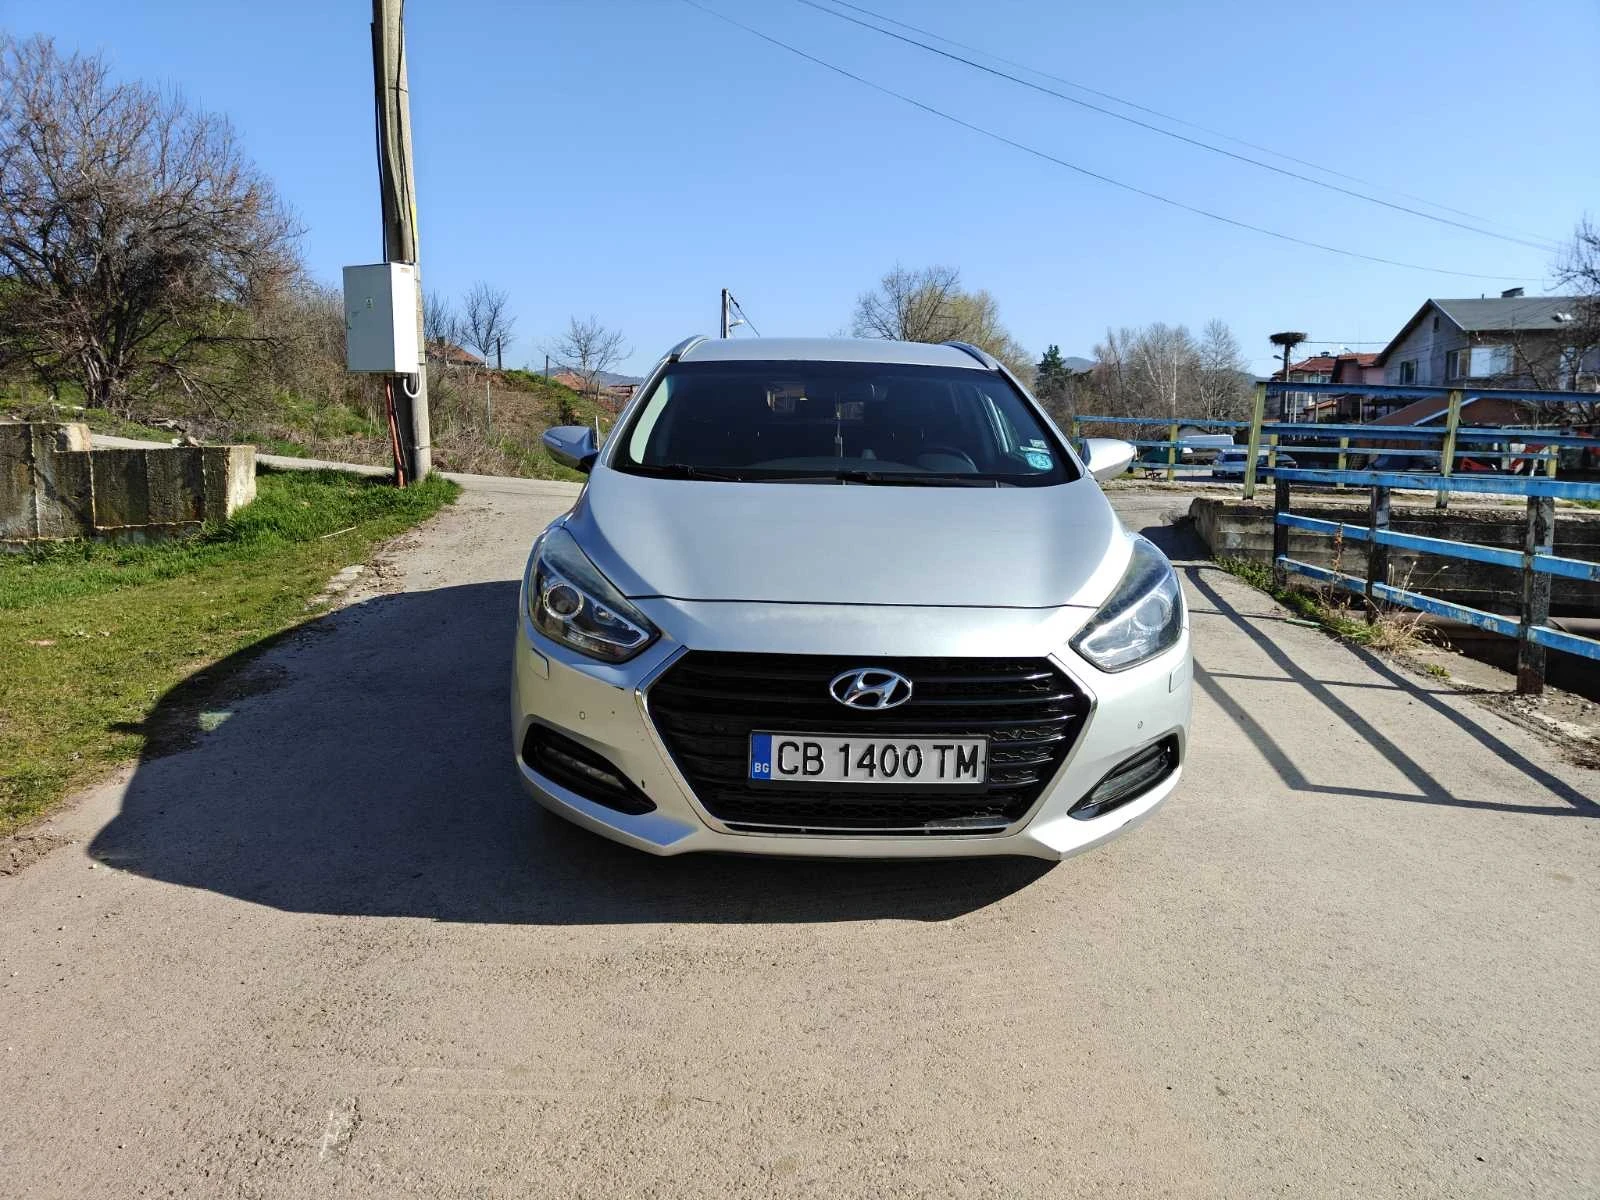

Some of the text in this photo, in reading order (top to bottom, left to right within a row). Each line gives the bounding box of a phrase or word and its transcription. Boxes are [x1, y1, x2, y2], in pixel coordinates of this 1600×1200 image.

[754, 763, 770, 774] BG
[777, 742, 979, 778] CB 1400 TM
